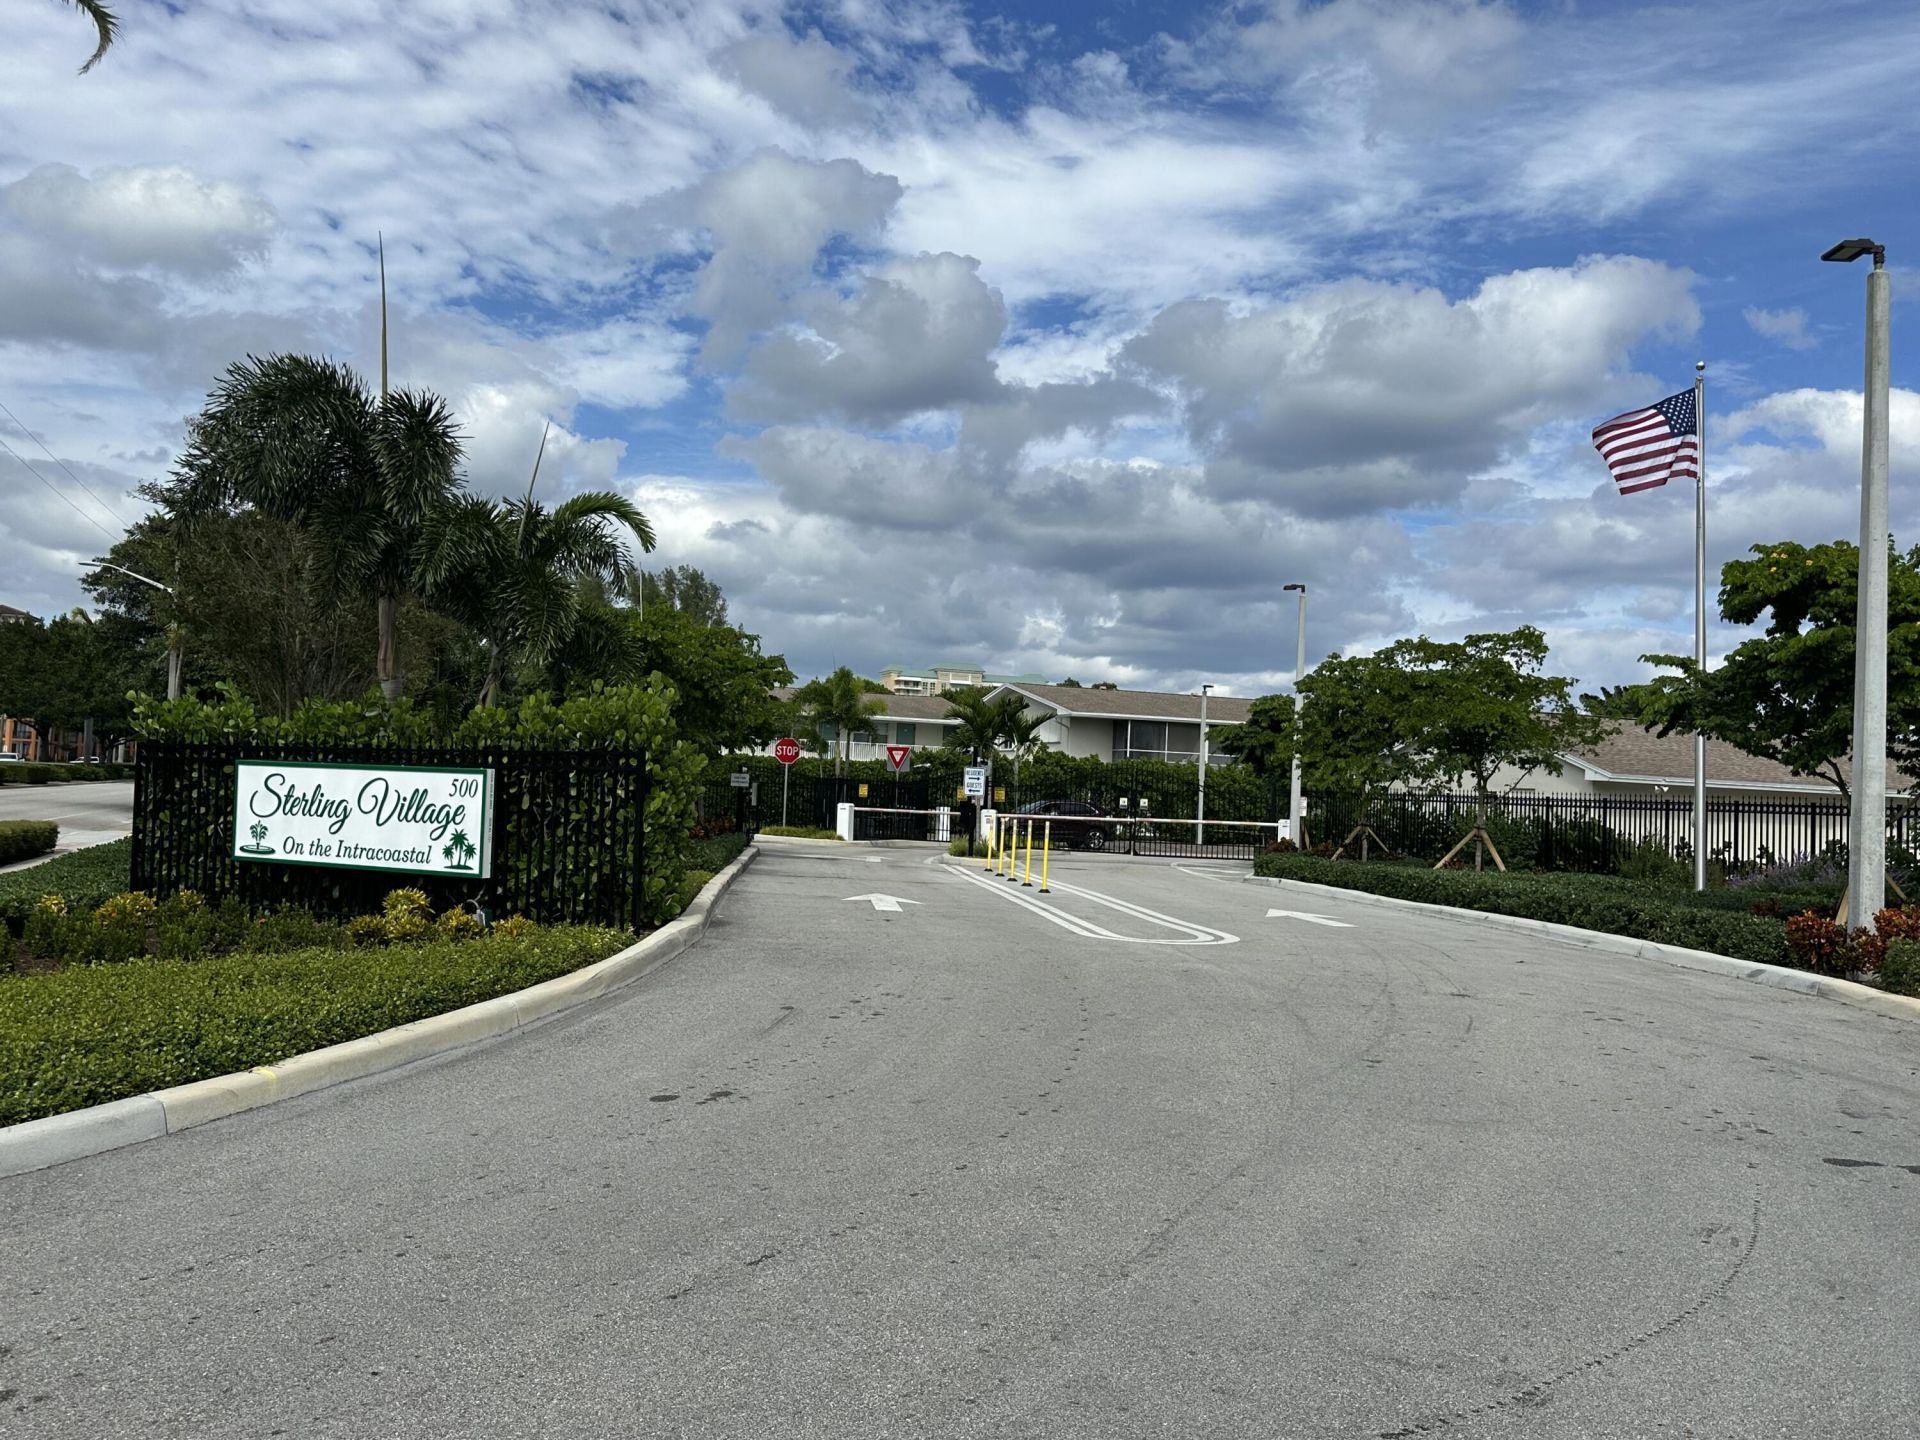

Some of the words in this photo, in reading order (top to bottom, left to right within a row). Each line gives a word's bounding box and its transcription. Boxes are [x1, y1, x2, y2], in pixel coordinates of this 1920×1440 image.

[776, 745, 799, 756] STOP
[448, 778, 479, 799] 500
[250, 773, 353, 835] Sterling
[357, 777, 466, 841] Village
[282, 835, 304, 856] On
[309, 838, 332, 858] the
[335, 839, 433, 865] Intracoastal
